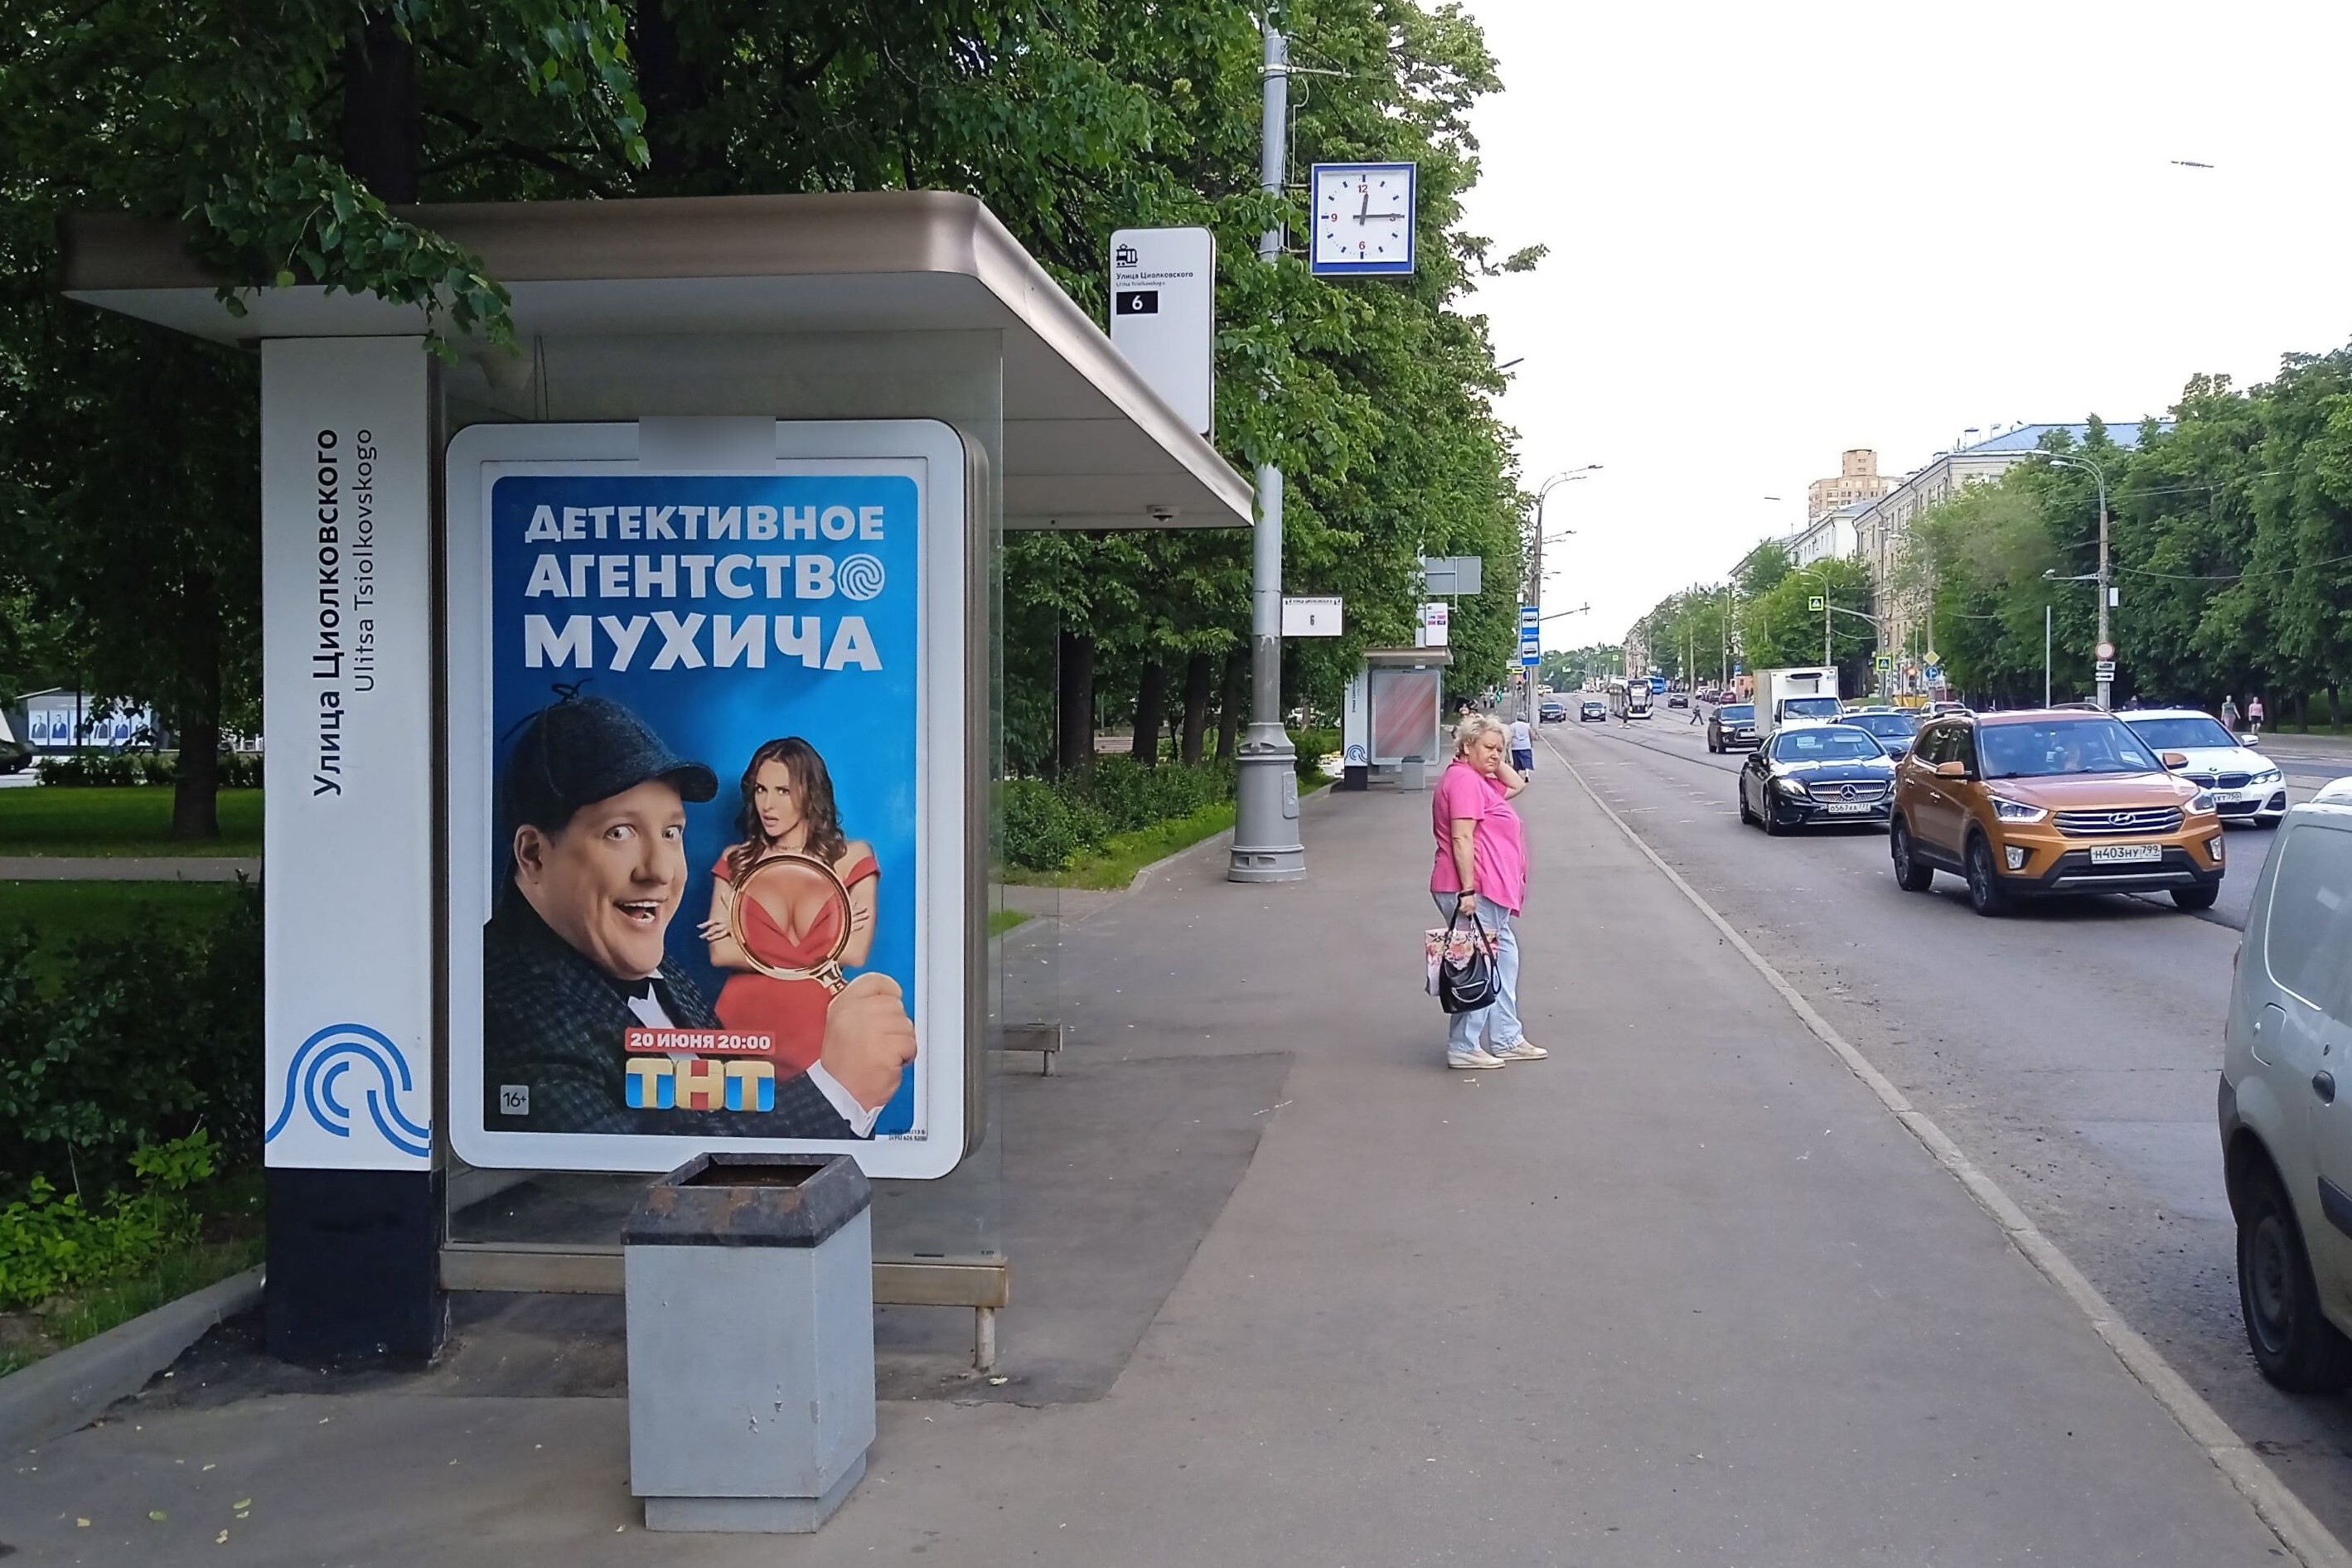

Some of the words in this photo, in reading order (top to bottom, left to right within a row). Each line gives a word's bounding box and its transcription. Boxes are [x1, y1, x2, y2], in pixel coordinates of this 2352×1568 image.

[1357, 184, 1368, 193] 12
[1331, 213, 1338, 222] 9
[1359, 240, 1366, 249] 6
[1132, 294, 1143, 311] 6
[351, 428, 377, 612] Tsiolkovskogo
[525, 505, 884, 543] ДЕТЕКТИВНОЕ
[312, 428, 345, 679] Циолковского
[525, 554, 886, 601] АГЕНТСТВО
[354, 618, 375, 693] Ulitsa
[525, 611, 883, 672] МУХИЧА
[312, 691, 345, 796] Улица
[630, 1033, 655, 1048] 20
[657, 1033, 714, 1049] ИЮНЯ
[717, 1034, 771, 1050] 20:00
[503, 1091, 527, 1108] 16+
[626, 1057, 775, 1111] ТНТ
